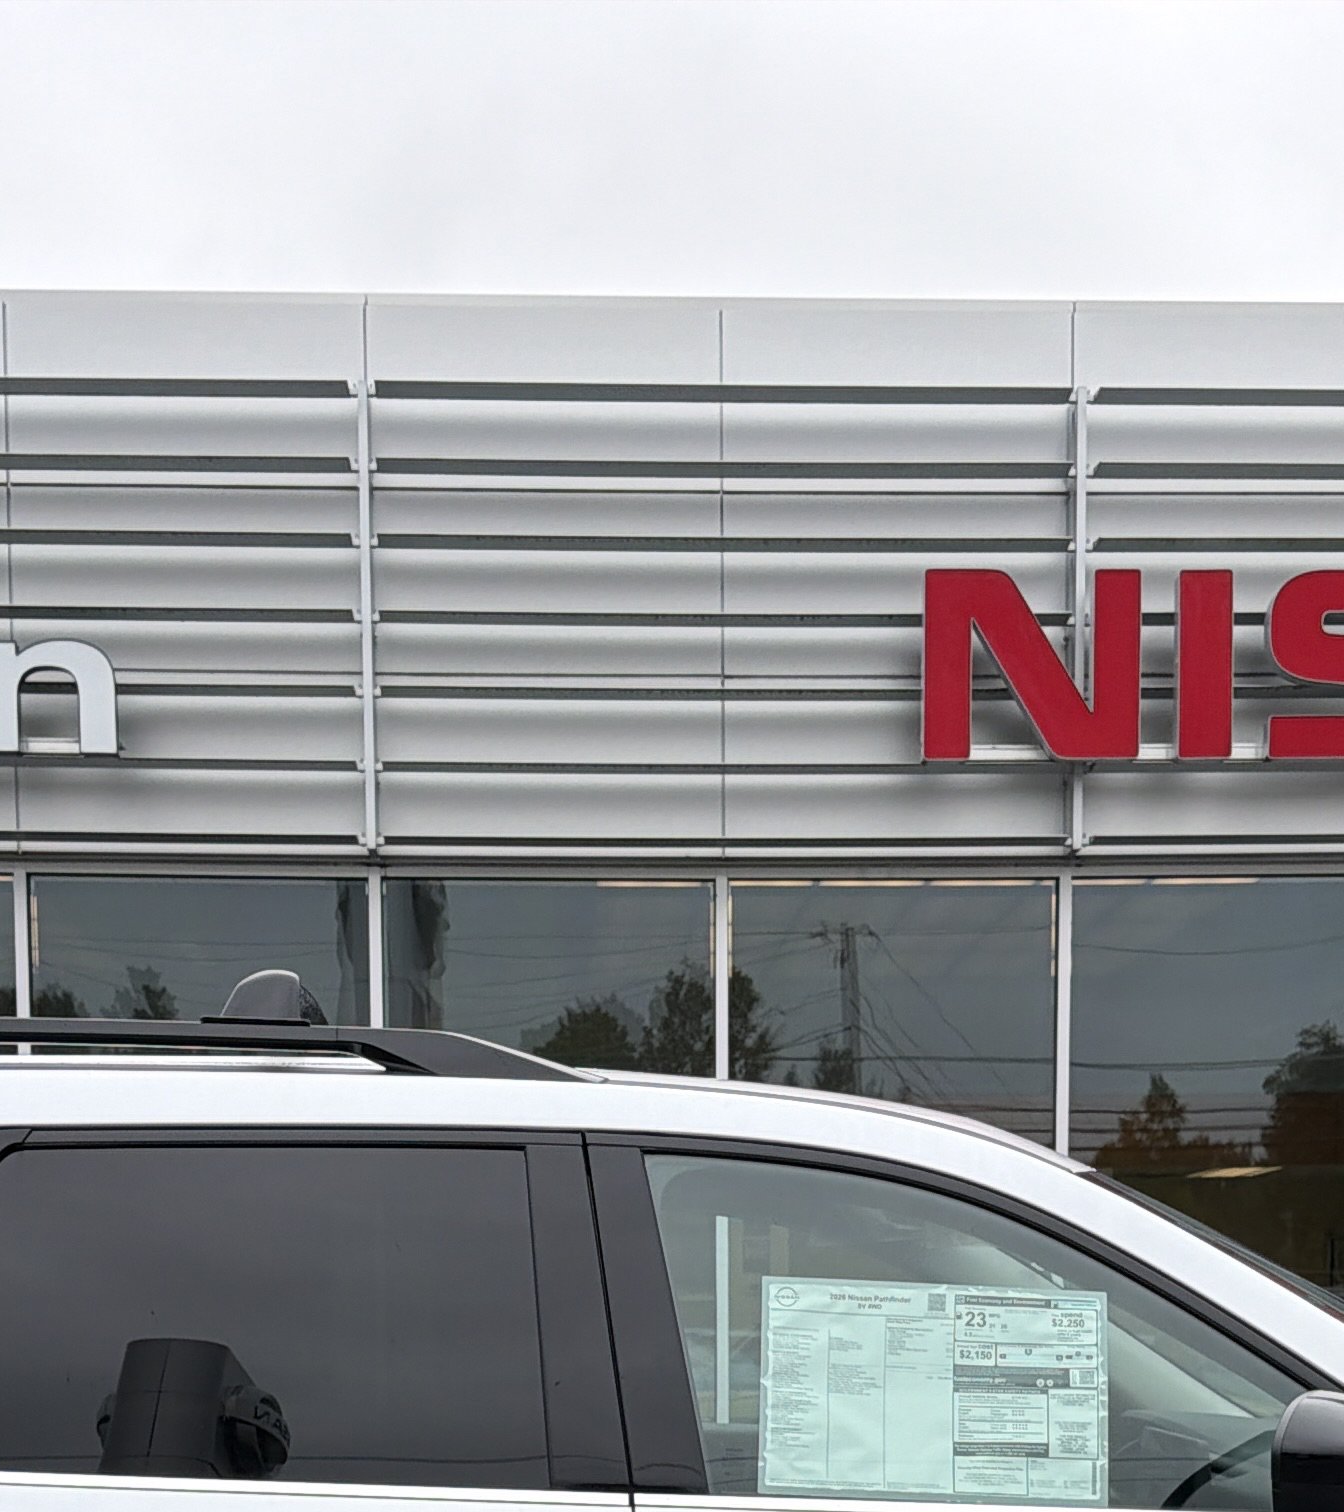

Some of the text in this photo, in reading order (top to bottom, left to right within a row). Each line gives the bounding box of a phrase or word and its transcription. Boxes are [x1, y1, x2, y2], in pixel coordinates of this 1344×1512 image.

[848, 1293, 872, 1302] Nissan
[873, 1295, 911, 1304] Pathfinder
[964, 1311, 987, 1328] 23
[959, 1349, 993, 1361] $2,150
